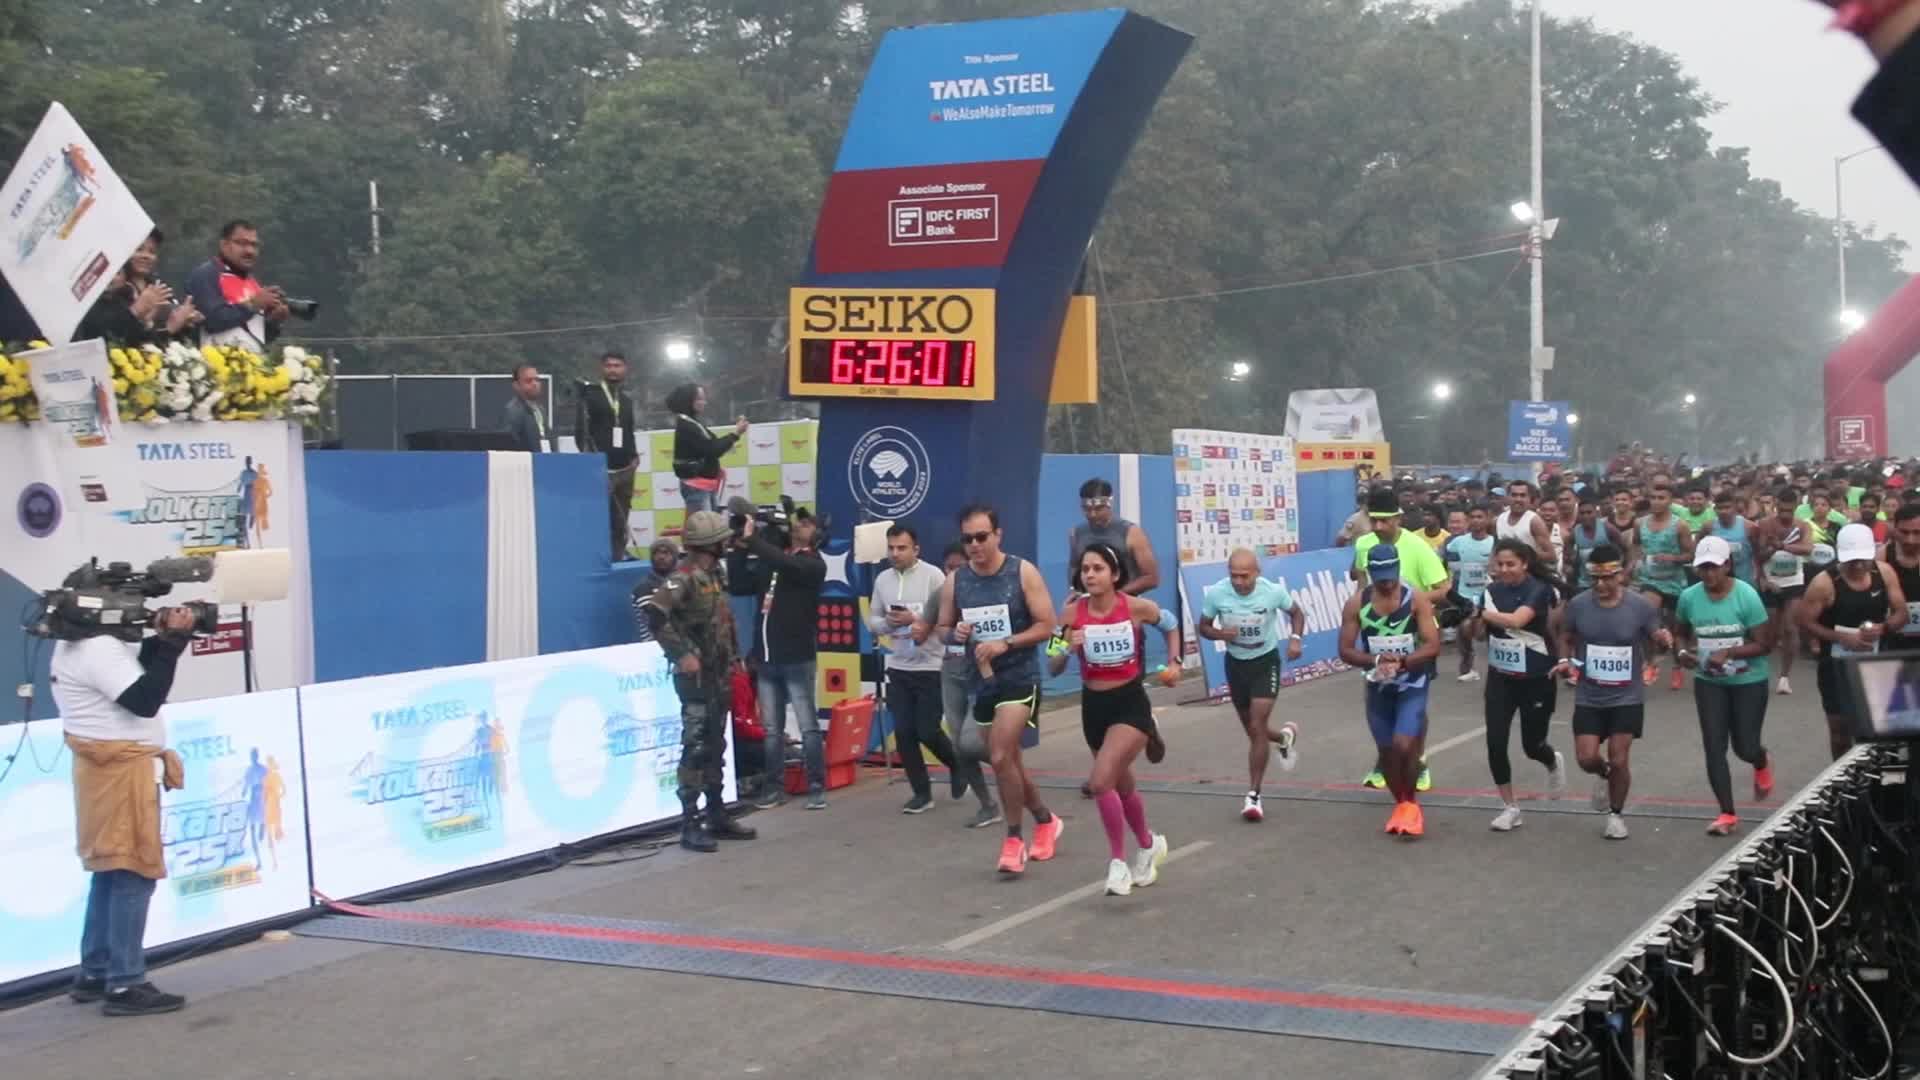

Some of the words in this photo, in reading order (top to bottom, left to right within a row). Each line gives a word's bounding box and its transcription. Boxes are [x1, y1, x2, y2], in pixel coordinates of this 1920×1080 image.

[929, 78, 990, 100] TATA
[993, 72, 1056, 96] STEEL
[899, 185, 945, 195] Associate
[946, 183, 986, 194] Sponsor
[926, 210, 954, 222] IDFC
[956, 207, 991, 221] FIRST
[926, 224, 956, 236] Bank
[803, 294, 973, 334] SEIKO
[831, 340, 974, 386] 6:26:01
[137, 443, 185, 461] TATA
[189, 442, 236, 460] STEEL
[975, 619, 1005, 635] 5462
[1092, 638, 1130, 653] 81155
[1592, 658, 1630, 673] 14304
[370, 705, 416, 732] TATA
[178, 735, 237, 760] STEEL
